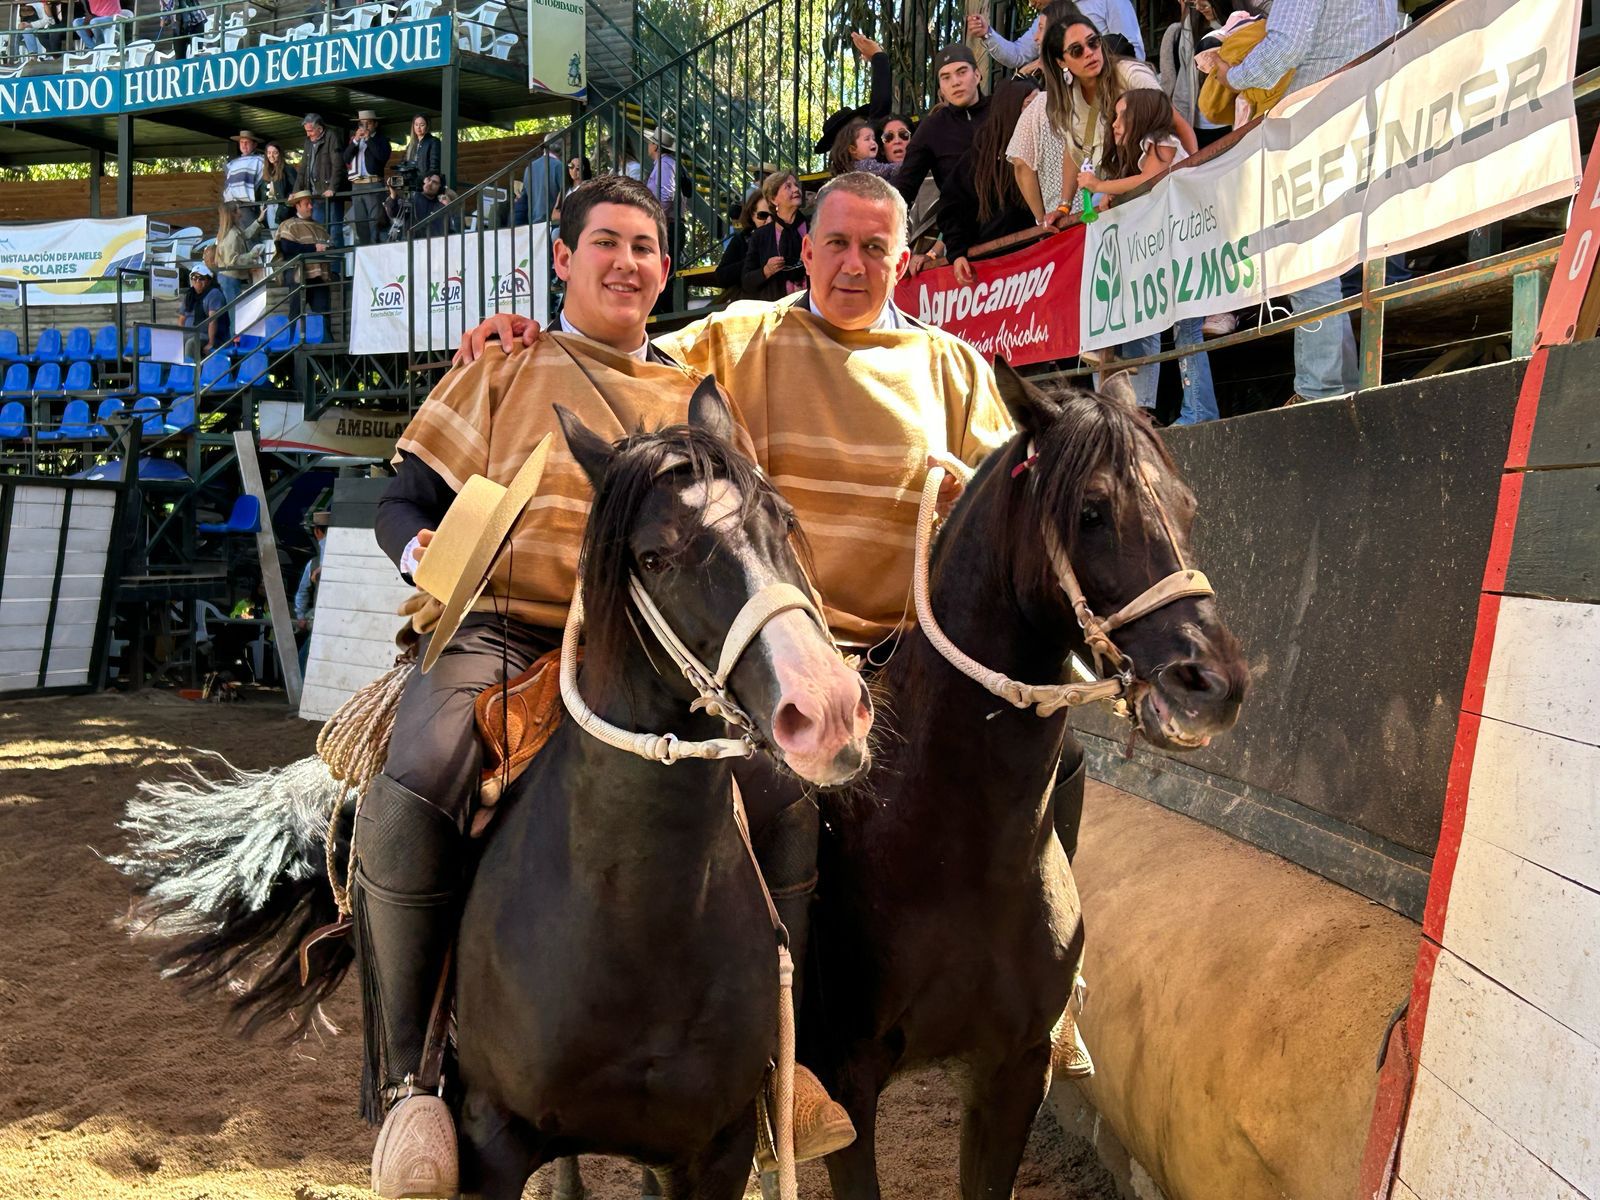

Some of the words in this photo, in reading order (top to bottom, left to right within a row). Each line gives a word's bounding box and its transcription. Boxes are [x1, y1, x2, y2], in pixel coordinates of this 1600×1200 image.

[0, 75, 113, 115] NANDO
[124, 52, 260, 106] HURTADO
[265, 23, 442, 84] ECHENIQUE
[1272, 46, 1548, 229] DEFENDER
[1, 251, 56, 263] INSTALACIÓN
[56, 253, 67, 262] DE
[68, 250, 103, 261] PANELES
[22, 263, 77, 275] SOLARES
[1127, 228, 1165, 264] Viveo
[919, 261, 1055, 328] Agrocampo
[1131, 267, 1169, 324] LOS
[995, 312, 1049, 361] Agrícolas
[336, 418, 408, 438] AMBULA
